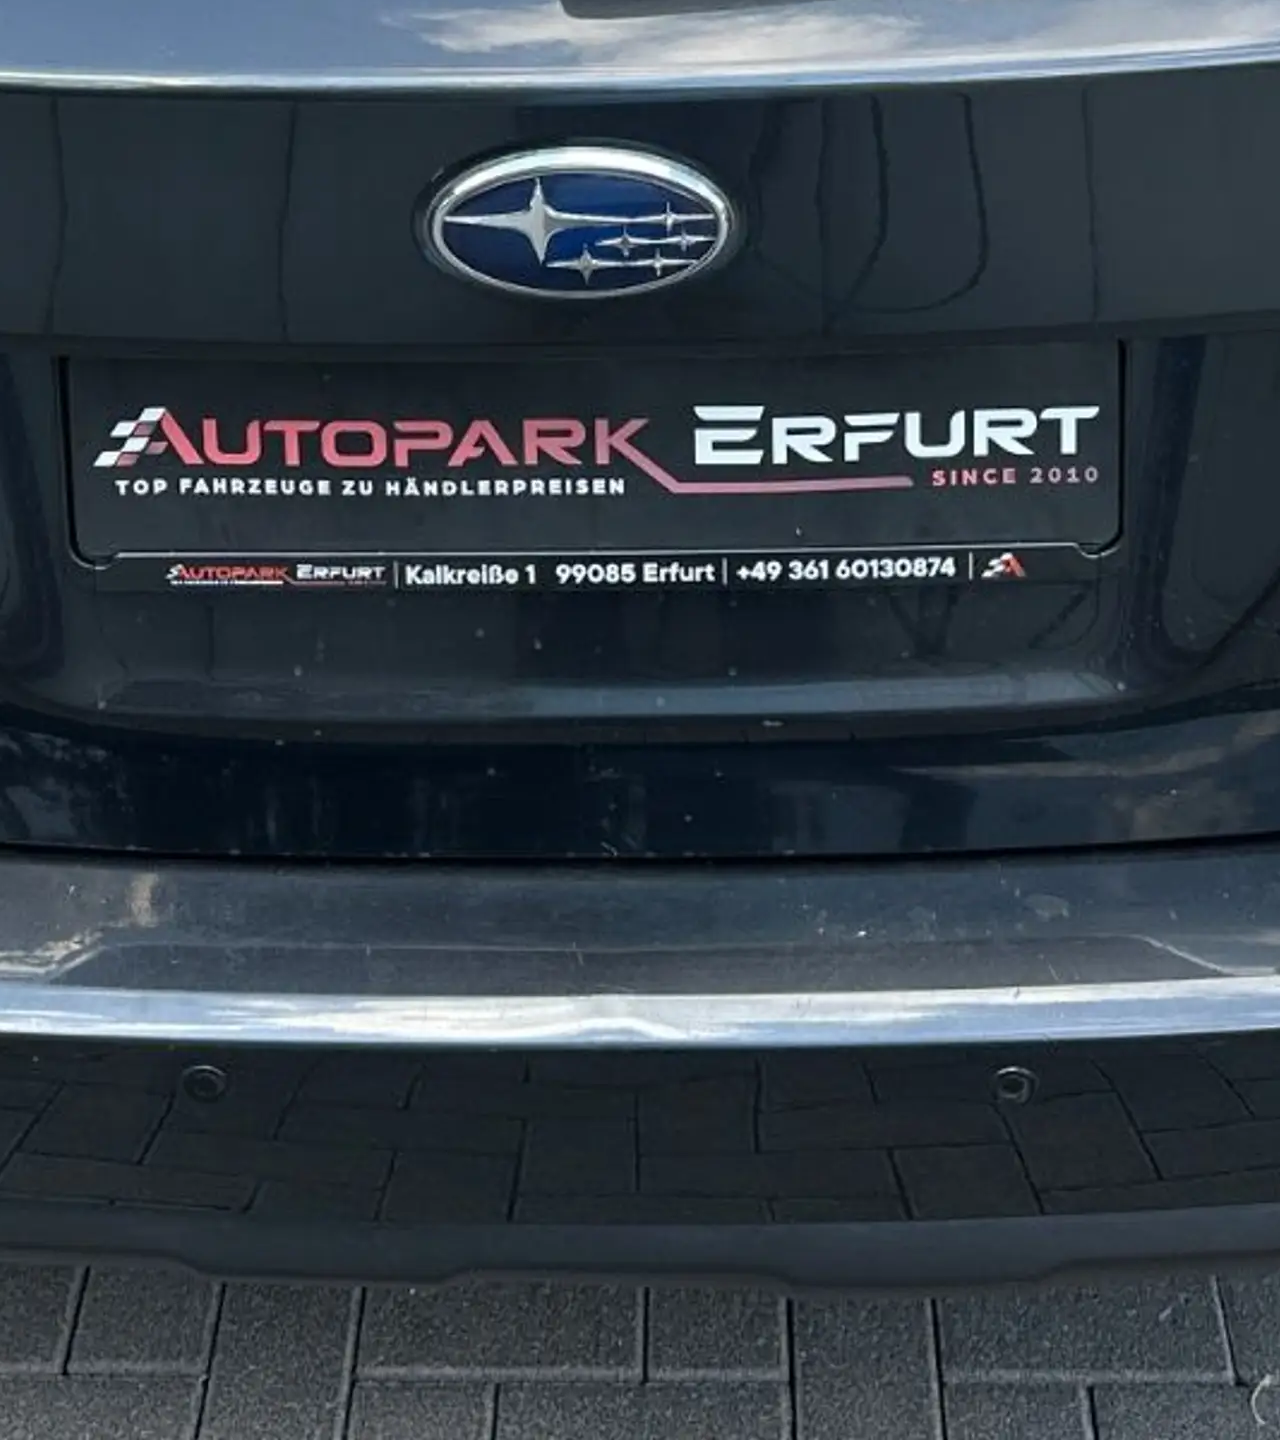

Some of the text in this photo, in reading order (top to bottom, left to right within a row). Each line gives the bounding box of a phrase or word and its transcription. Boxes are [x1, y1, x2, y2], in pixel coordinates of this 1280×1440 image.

[93, 404, 1100, 468] AUTOPARK ERFURT
[115, 474, 626, 498] TOP FAHRZEUGE ZU HÄNDLERPREISEN
[931, 466, 1100, 487] SINCE 2010
[166, 563, 290, 581] AUTOPARK
[295, 562, 387, 580] ERFURT
[405, 563, 519, 585] Kalkreiße
[524, 564, 537, 585] 1
[555, 562, 637, 584] 99085
[642, 561, 716, 583] Erfurt
[736, 560, 781, 581] +49
[788, 559, 829, 580] 361
[835, 557, 956, 579] 60130874
